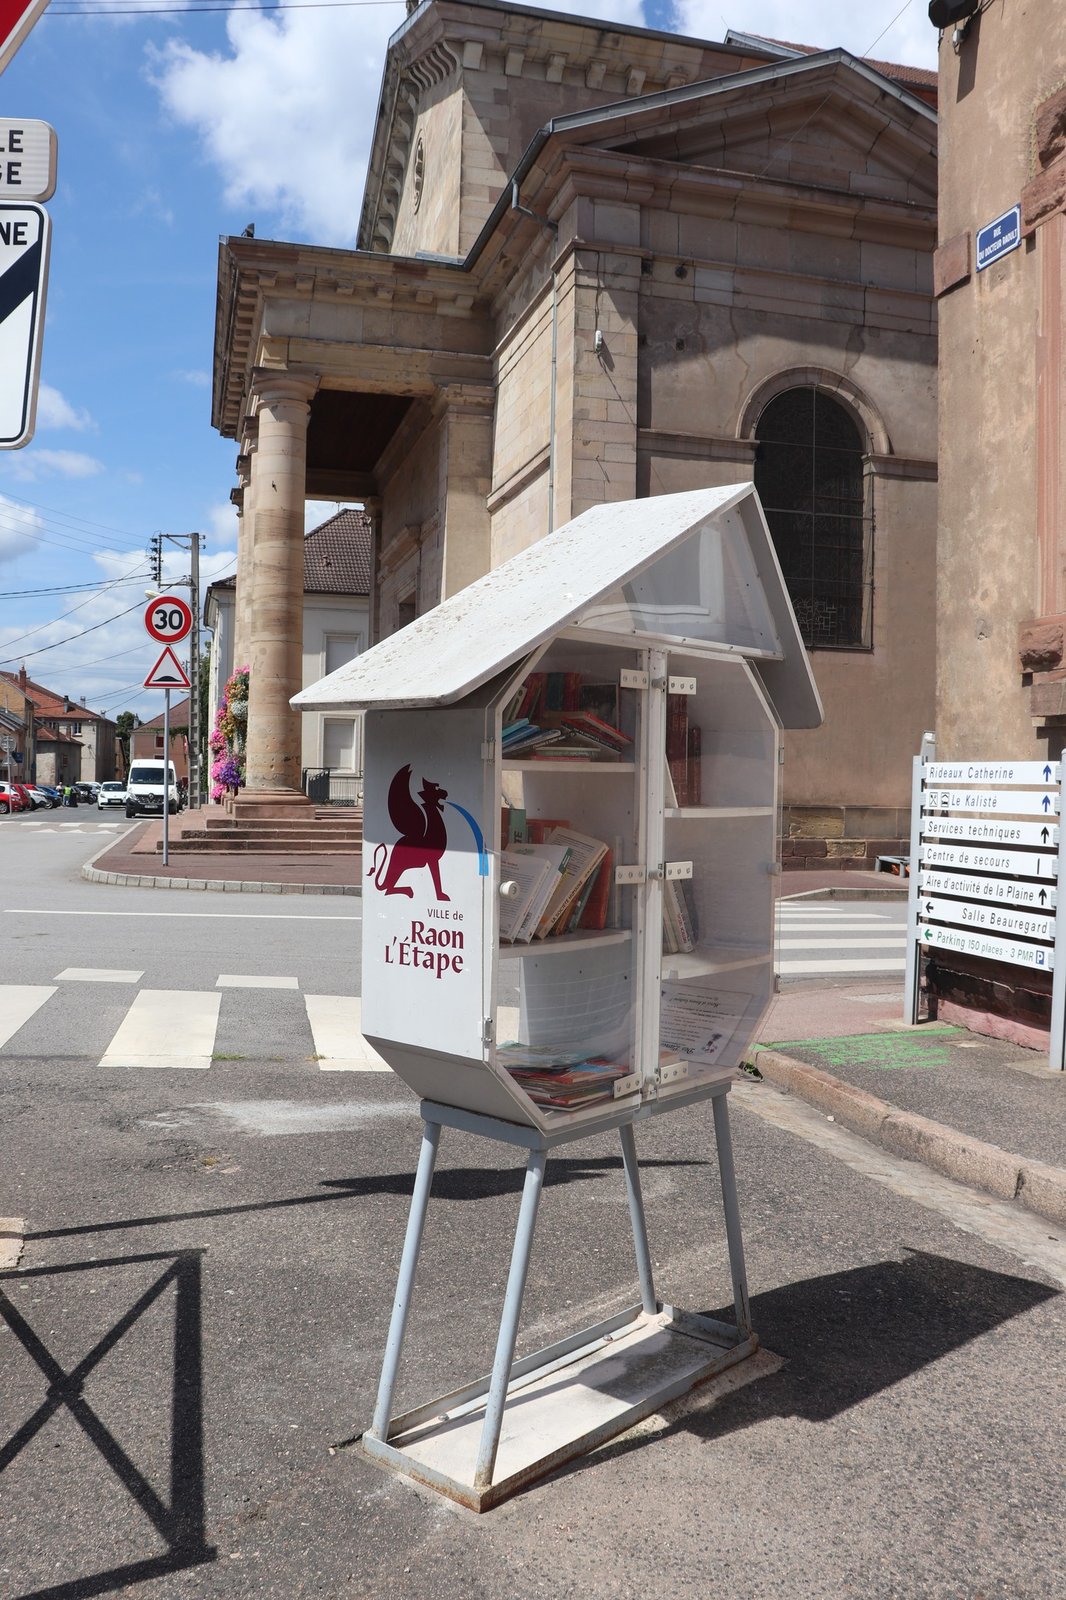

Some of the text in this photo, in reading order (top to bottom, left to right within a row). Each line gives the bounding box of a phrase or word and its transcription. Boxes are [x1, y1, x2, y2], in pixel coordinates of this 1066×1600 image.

[154, 609, 184, 630] 30
[929, 766, 1014, 779] Rideaux Catherine
[952, 794, 998, 807] Le Kalisté
[927, 821, 1021, 840] Services techniques
[926, 848, 1010, 868] Centre de secours
[926, 875, 1034, 901] Aire d'activité de la Plaine
[427, 908, 464, 921] VILLE de
[962, 908, 1048, 934] Salle Beauregard
[411, 920, 464, 949] Raon
[936, 931, 966, 950] Parking
[967, 939, 980, 951] 150
[981, 943, 1003, 955] places
[1010, 948, 1016, 958] 3
[1017, 949, 1034, 962] PMR
[385, 936, 464, 979] L'Étape
